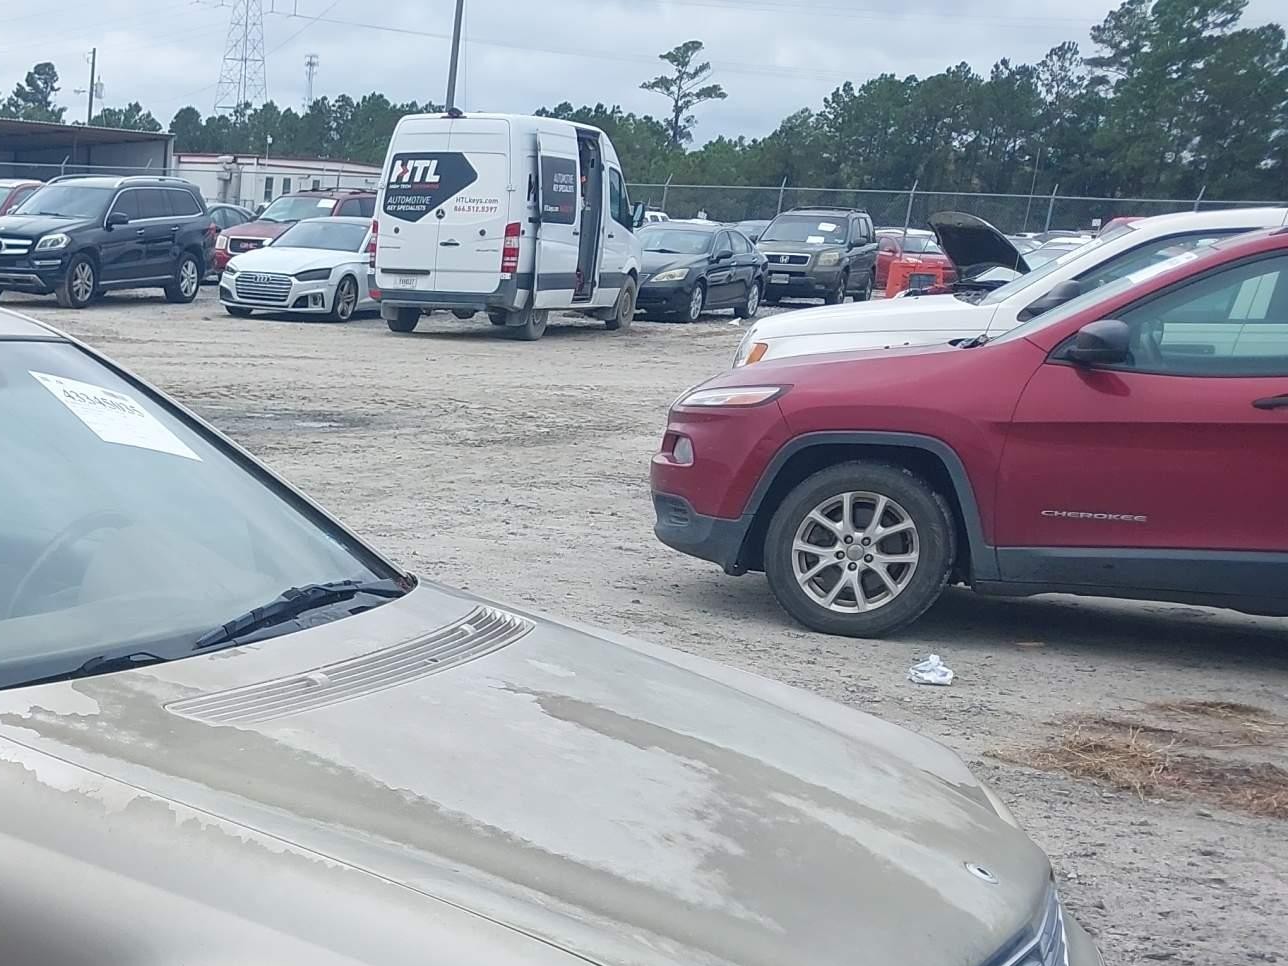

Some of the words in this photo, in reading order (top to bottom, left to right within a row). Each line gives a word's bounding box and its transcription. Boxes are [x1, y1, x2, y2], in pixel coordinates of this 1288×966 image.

[390, 160, 441, 182] HTL
[387, 196, 432, 204] AUTOMOTIVE
[455, 196, 499, 205] HTLkeys.com
[1040, 510, 1148, 522] CHEROKEE
